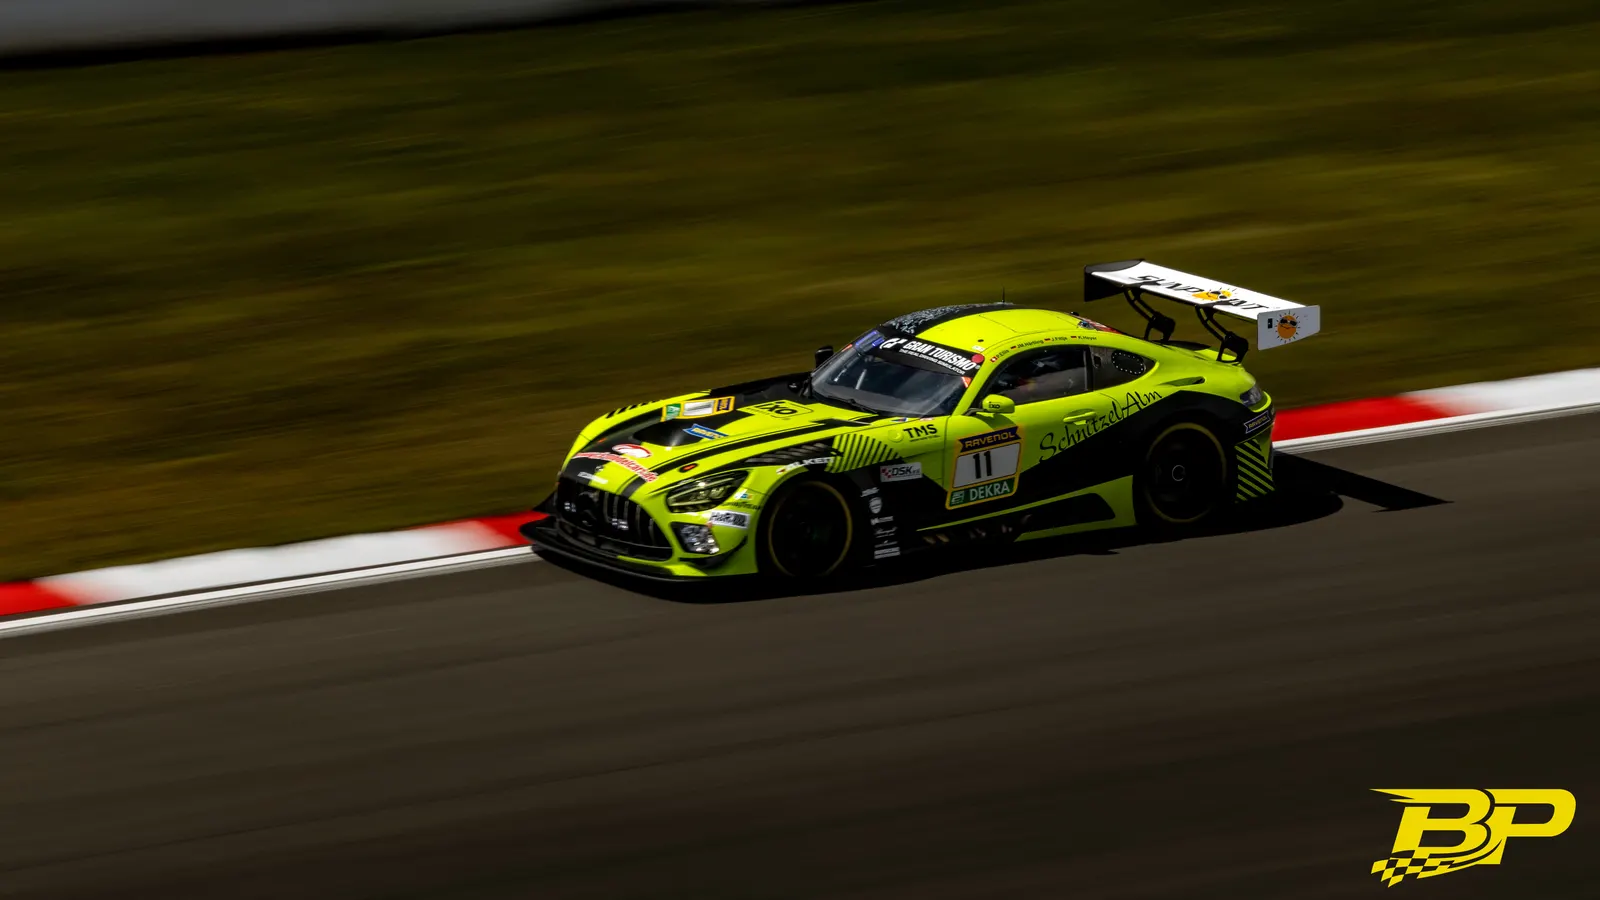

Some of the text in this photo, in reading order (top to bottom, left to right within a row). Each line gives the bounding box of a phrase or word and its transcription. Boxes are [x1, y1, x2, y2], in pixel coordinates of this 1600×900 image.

[903, 341, 976, 370] GRAN TURISMO
[903, 424, 938, 439] TMS
[964, 432, 1015, 449] RAVENOL
[891, 466, 913, 476] DSK
[973, 450, 992, 479] 11
[969, 481, 1010, 501] DEKRA
